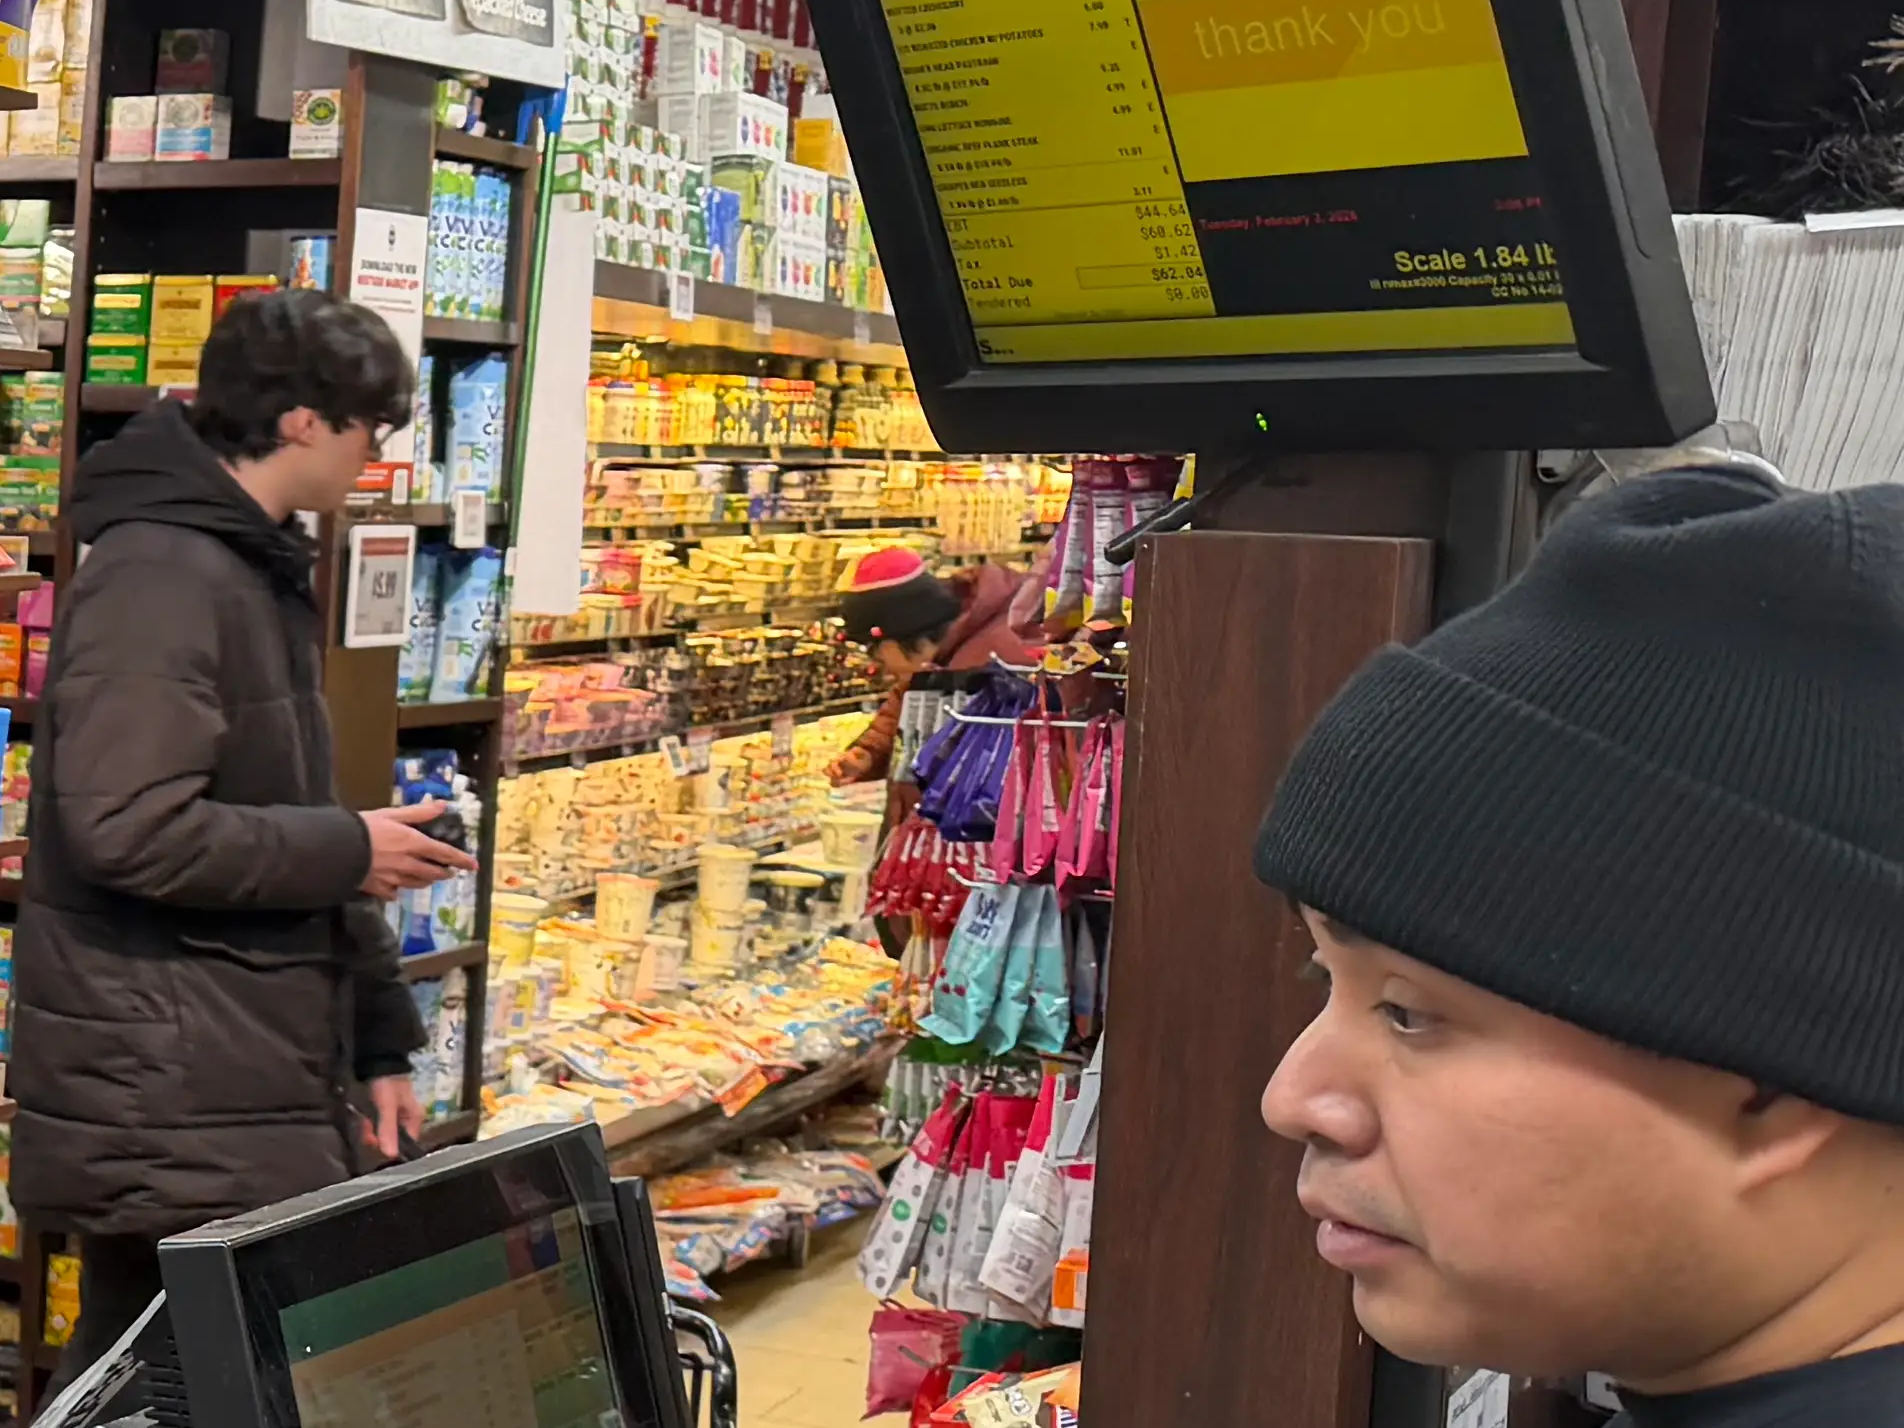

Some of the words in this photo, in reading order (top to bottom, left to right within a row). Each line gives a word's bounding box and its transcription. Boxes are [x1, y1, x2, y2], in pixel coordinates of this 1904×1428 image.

[998, 28, 1045, 44] POTATOES
[1193, 6, 1337, 61] thank
[1135, 204, 1188, 221] $44.64
[951, 236, 1015, 251] Subtotal
[1140, 224, 1193, 240] $60.62
[957, 257, 982, 270] Tax
[1154, 244, 1198, 260] $1.42
[1393, 247, 1467, 274] Scale
[1473, 244, 1529, 269] 1.84
[963, 277, 1002, 292] Total
[1008, 275, 1034, 289] Due
[1151, 266, 1204, 282] $62.04
[968, 295, 1032, 310] Tendered
[1165, 286, 1210, 302] $0.00
